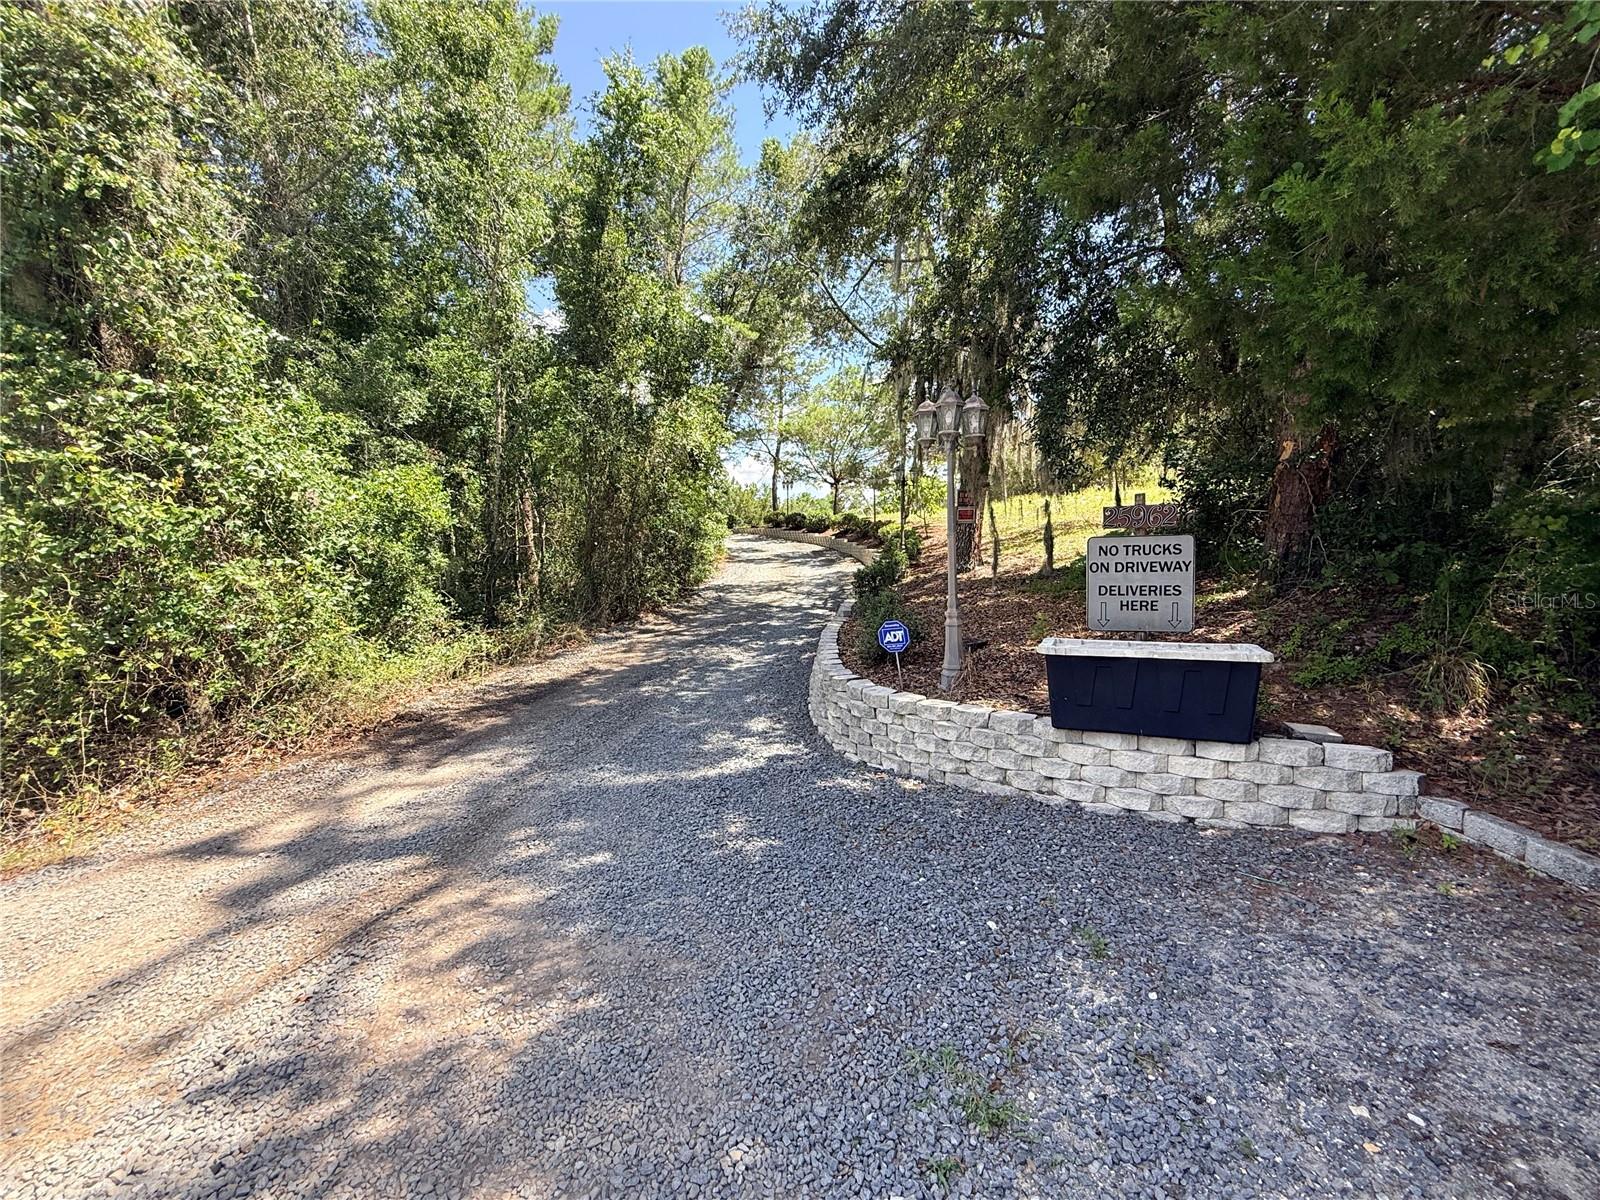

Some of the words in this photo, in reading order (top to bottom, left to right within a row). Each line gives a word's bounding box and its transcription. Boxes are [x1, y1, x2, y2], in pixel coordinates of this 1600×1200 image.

[1103, 504, 1177, 528] 25962
[1098, 544, 1119, 556] NO
[1123, 543, 1183, 556] TRUCKS
[1089, 562, 1110, 573] ON
[1114, 560, 1192, 573] DRIVEWAY
[1098, 584, 1182, 597] DELIVERIES
[1119, 600, 1159, 611] HERE
[884, 630, 904, 643] ADT
